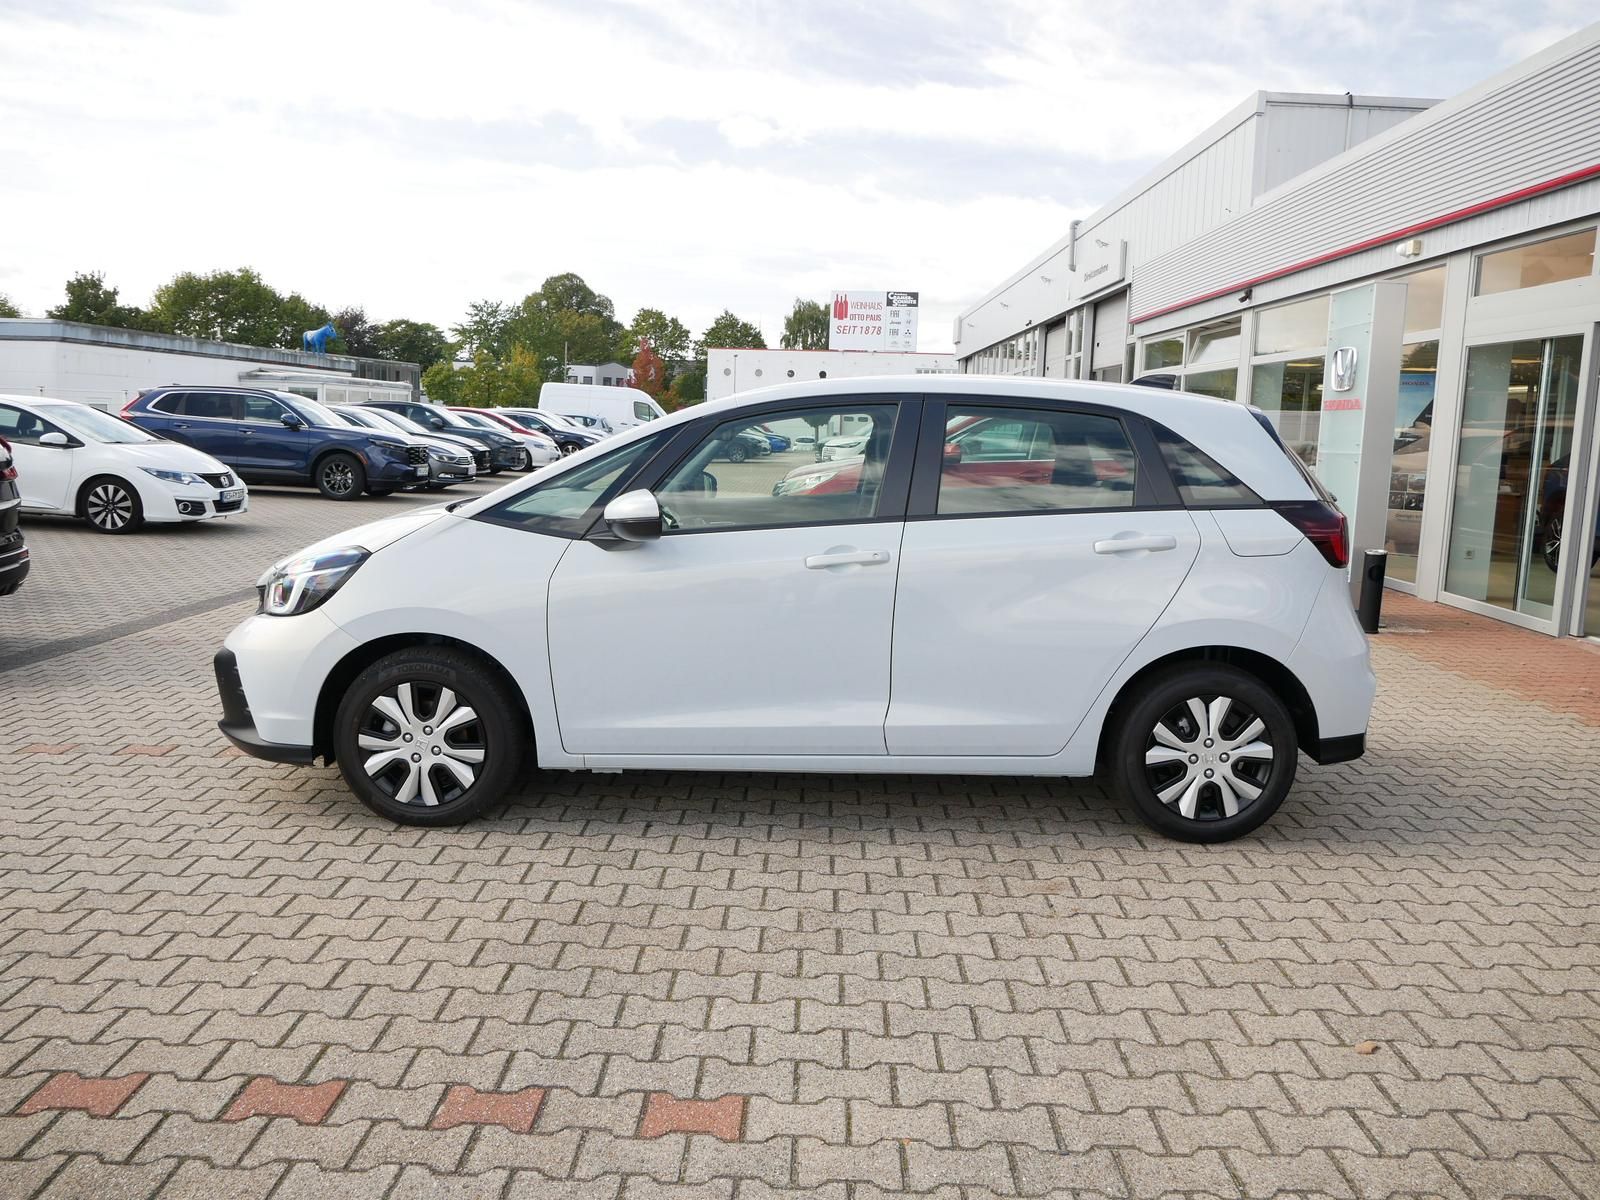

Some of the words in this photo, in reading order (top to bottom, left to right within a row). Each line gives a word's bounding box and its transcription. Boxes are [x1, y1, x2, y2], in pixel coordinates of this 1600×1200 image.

[850, 301, 883, 310] WEINHAUS
[849, 313, 865, 321] OTTO
[865, 313, 882, 322] PAUS
[836, 325, 857, 335] SEIT
[860, 325, 882, 335] 1878
[1323, 398, 1361, 410] HONDA
